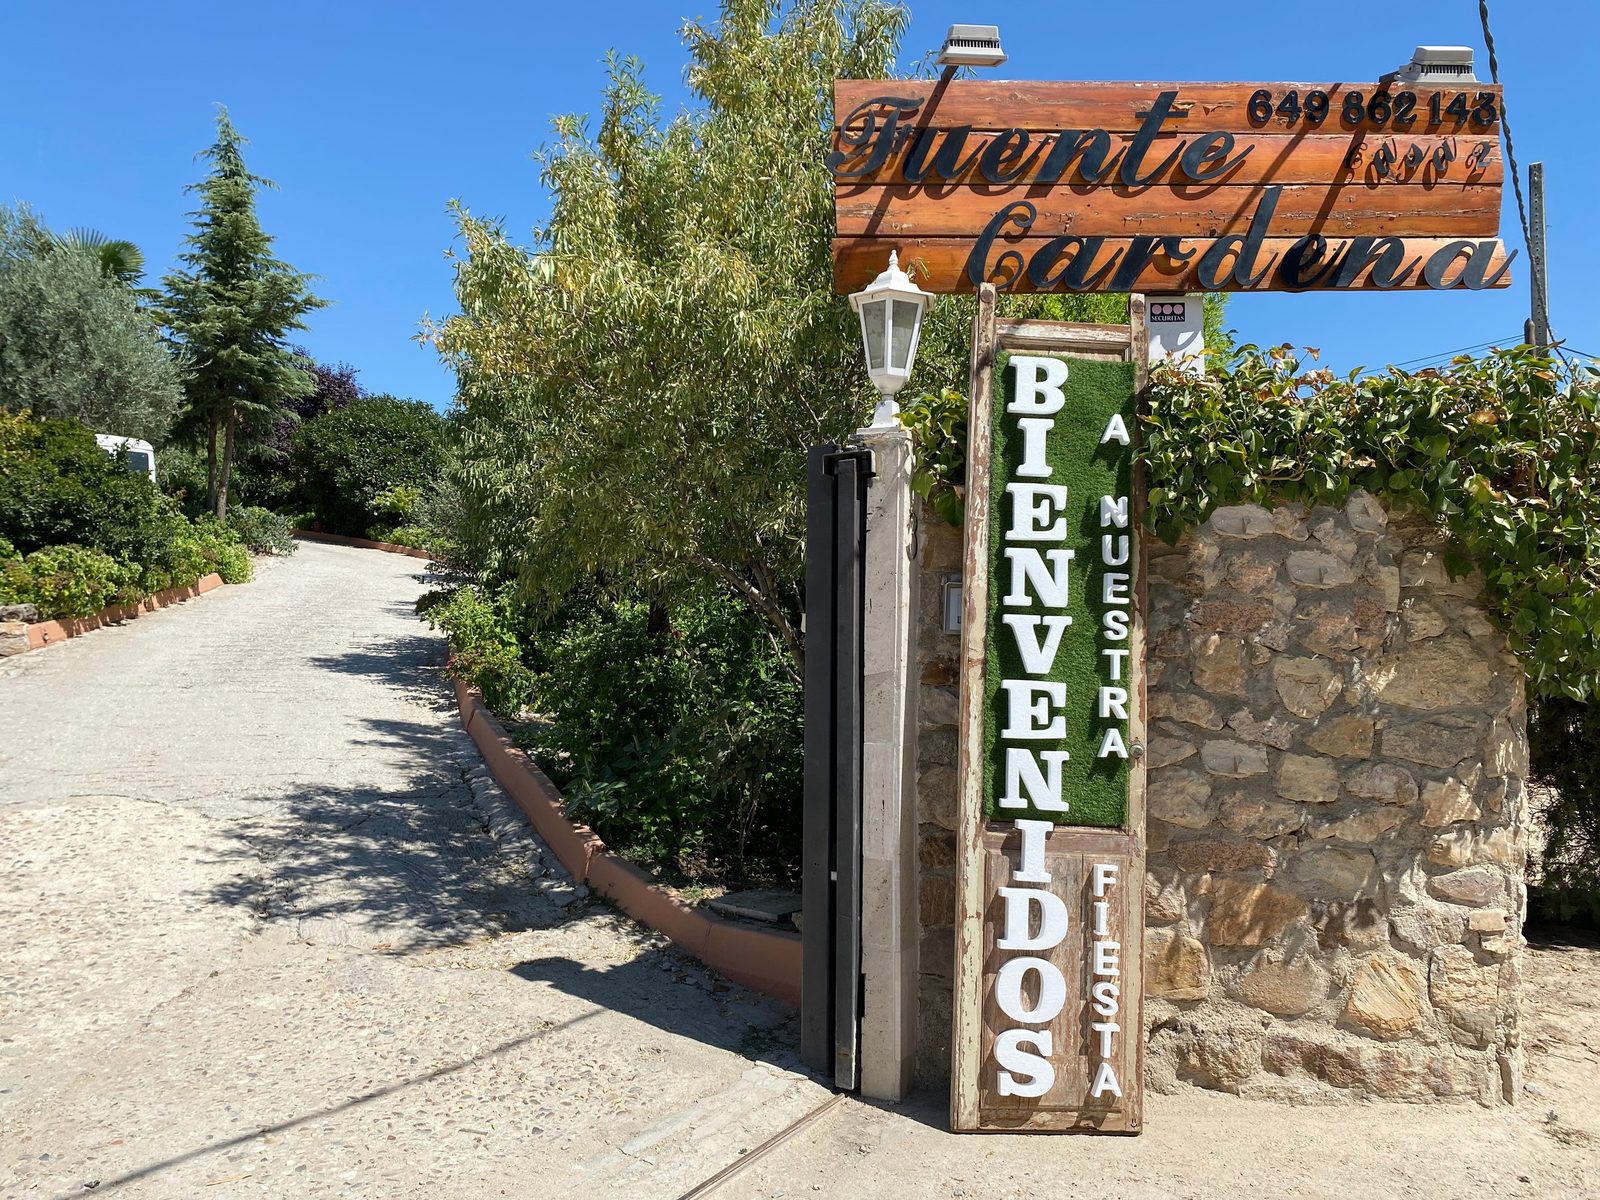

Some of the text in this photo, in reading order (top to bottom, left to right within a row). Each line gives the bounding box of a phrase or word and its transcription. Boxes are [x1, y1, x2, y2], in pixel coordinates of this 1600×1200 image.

[826, 90, 1255, 184] Fuente
[1248, 90, 1497, 125] 649 862 143
[1472, 141, 1492, 168] 2
[967, 186, 1518, 291] Cardena
[993, 355, 1075, 1098] BIENVENIDOS
[1090, 413, 1131, 1098] A NUESTRA FIESTA
